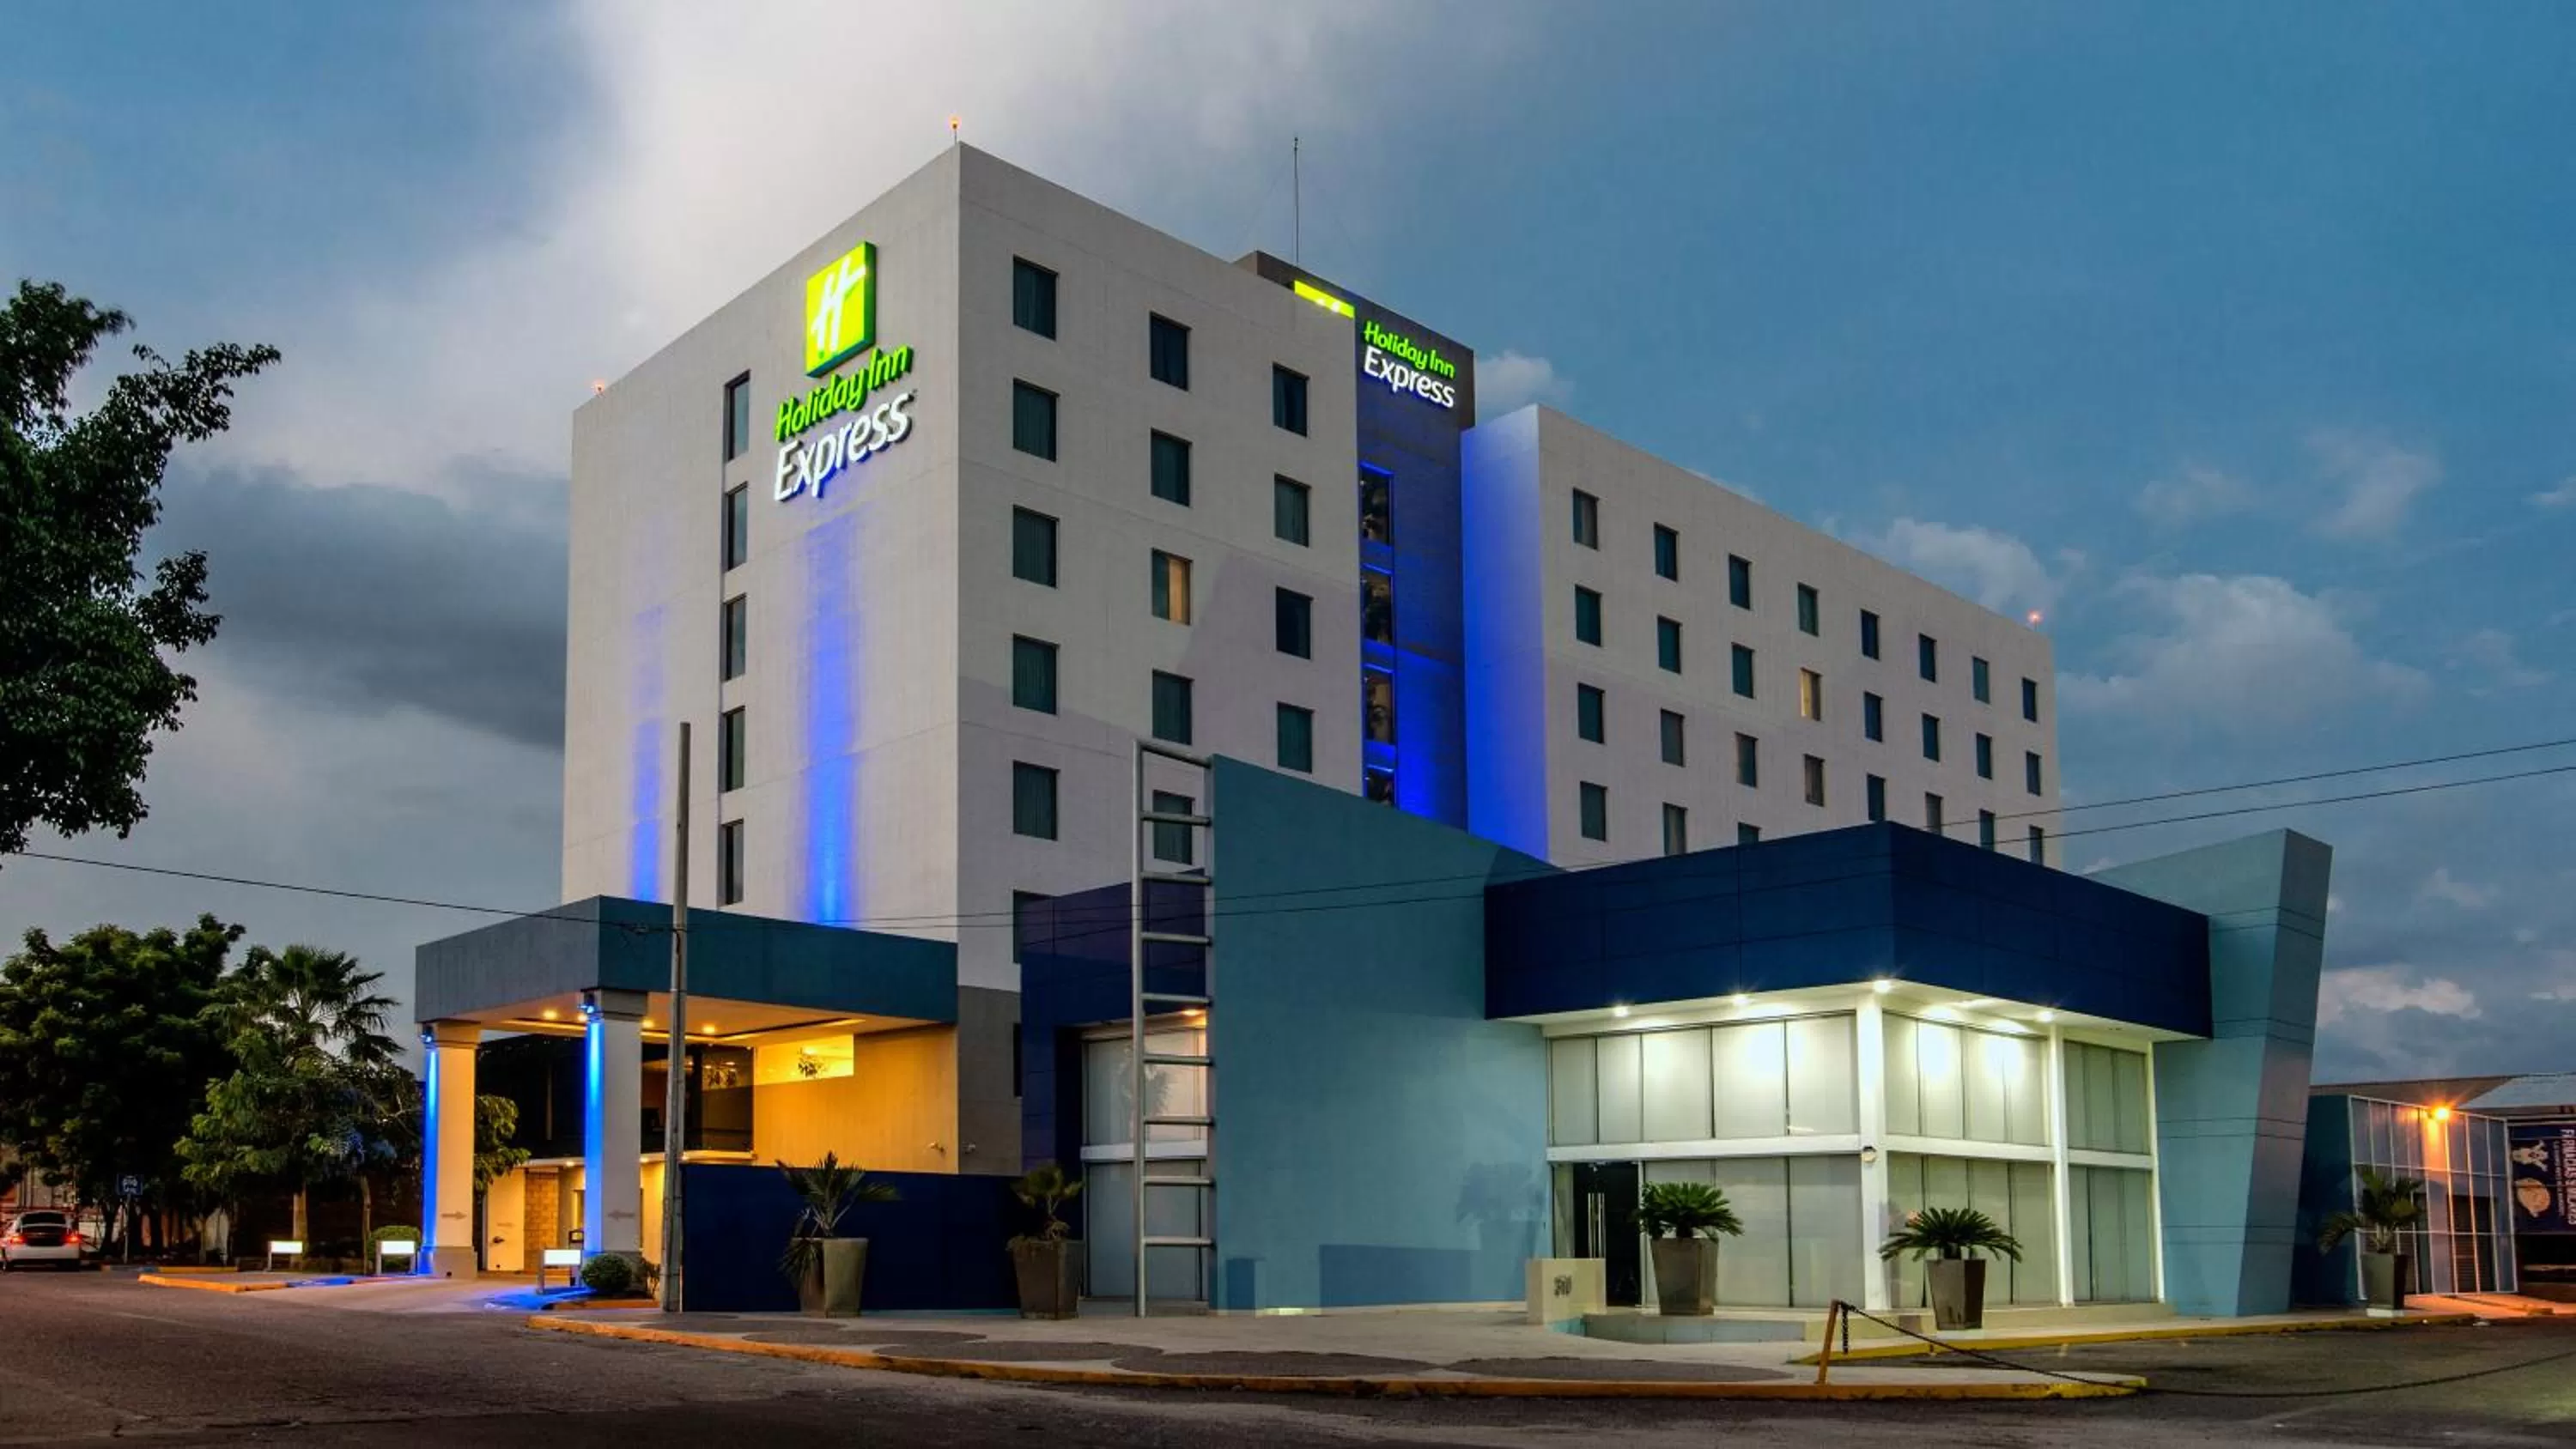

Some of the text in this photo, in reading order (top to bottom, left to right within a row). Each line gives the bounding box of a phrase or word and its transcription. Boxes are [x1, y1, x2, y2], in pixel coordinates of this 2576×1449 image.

[1364, 320, 1455, 379] Holiday Inn
[1364, 345, 1455, 409] Express
[775, 345, 910, 441] Holiday Inn
[775, 391, 912, 501] Express
